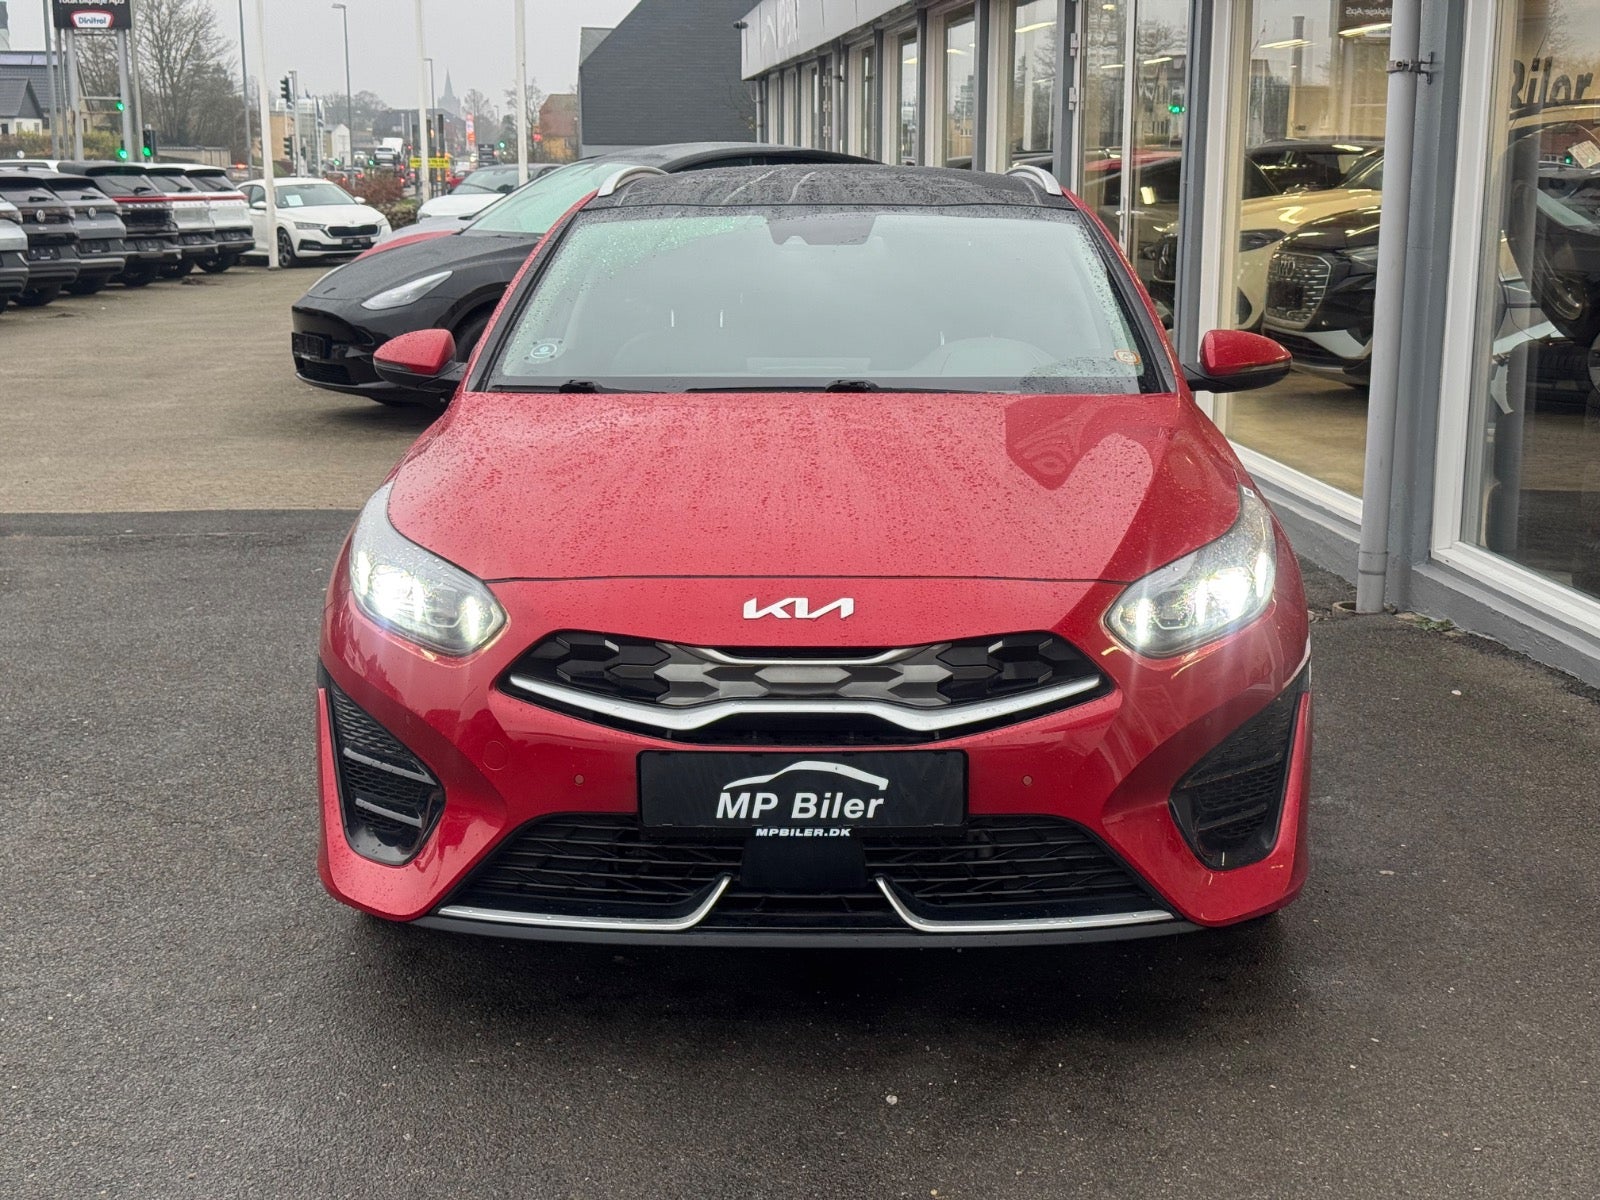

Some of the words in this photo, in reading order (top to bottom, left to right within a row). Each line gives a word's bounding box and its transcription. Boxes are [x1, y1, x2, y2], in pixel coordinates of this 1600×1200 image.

[78, 16, 107, 25] Dinitrol
[716, 792, 779, 819] MP
[791, 792, 884, 819] Biler
[755, 828, 852, 837] MPBILER.DK
